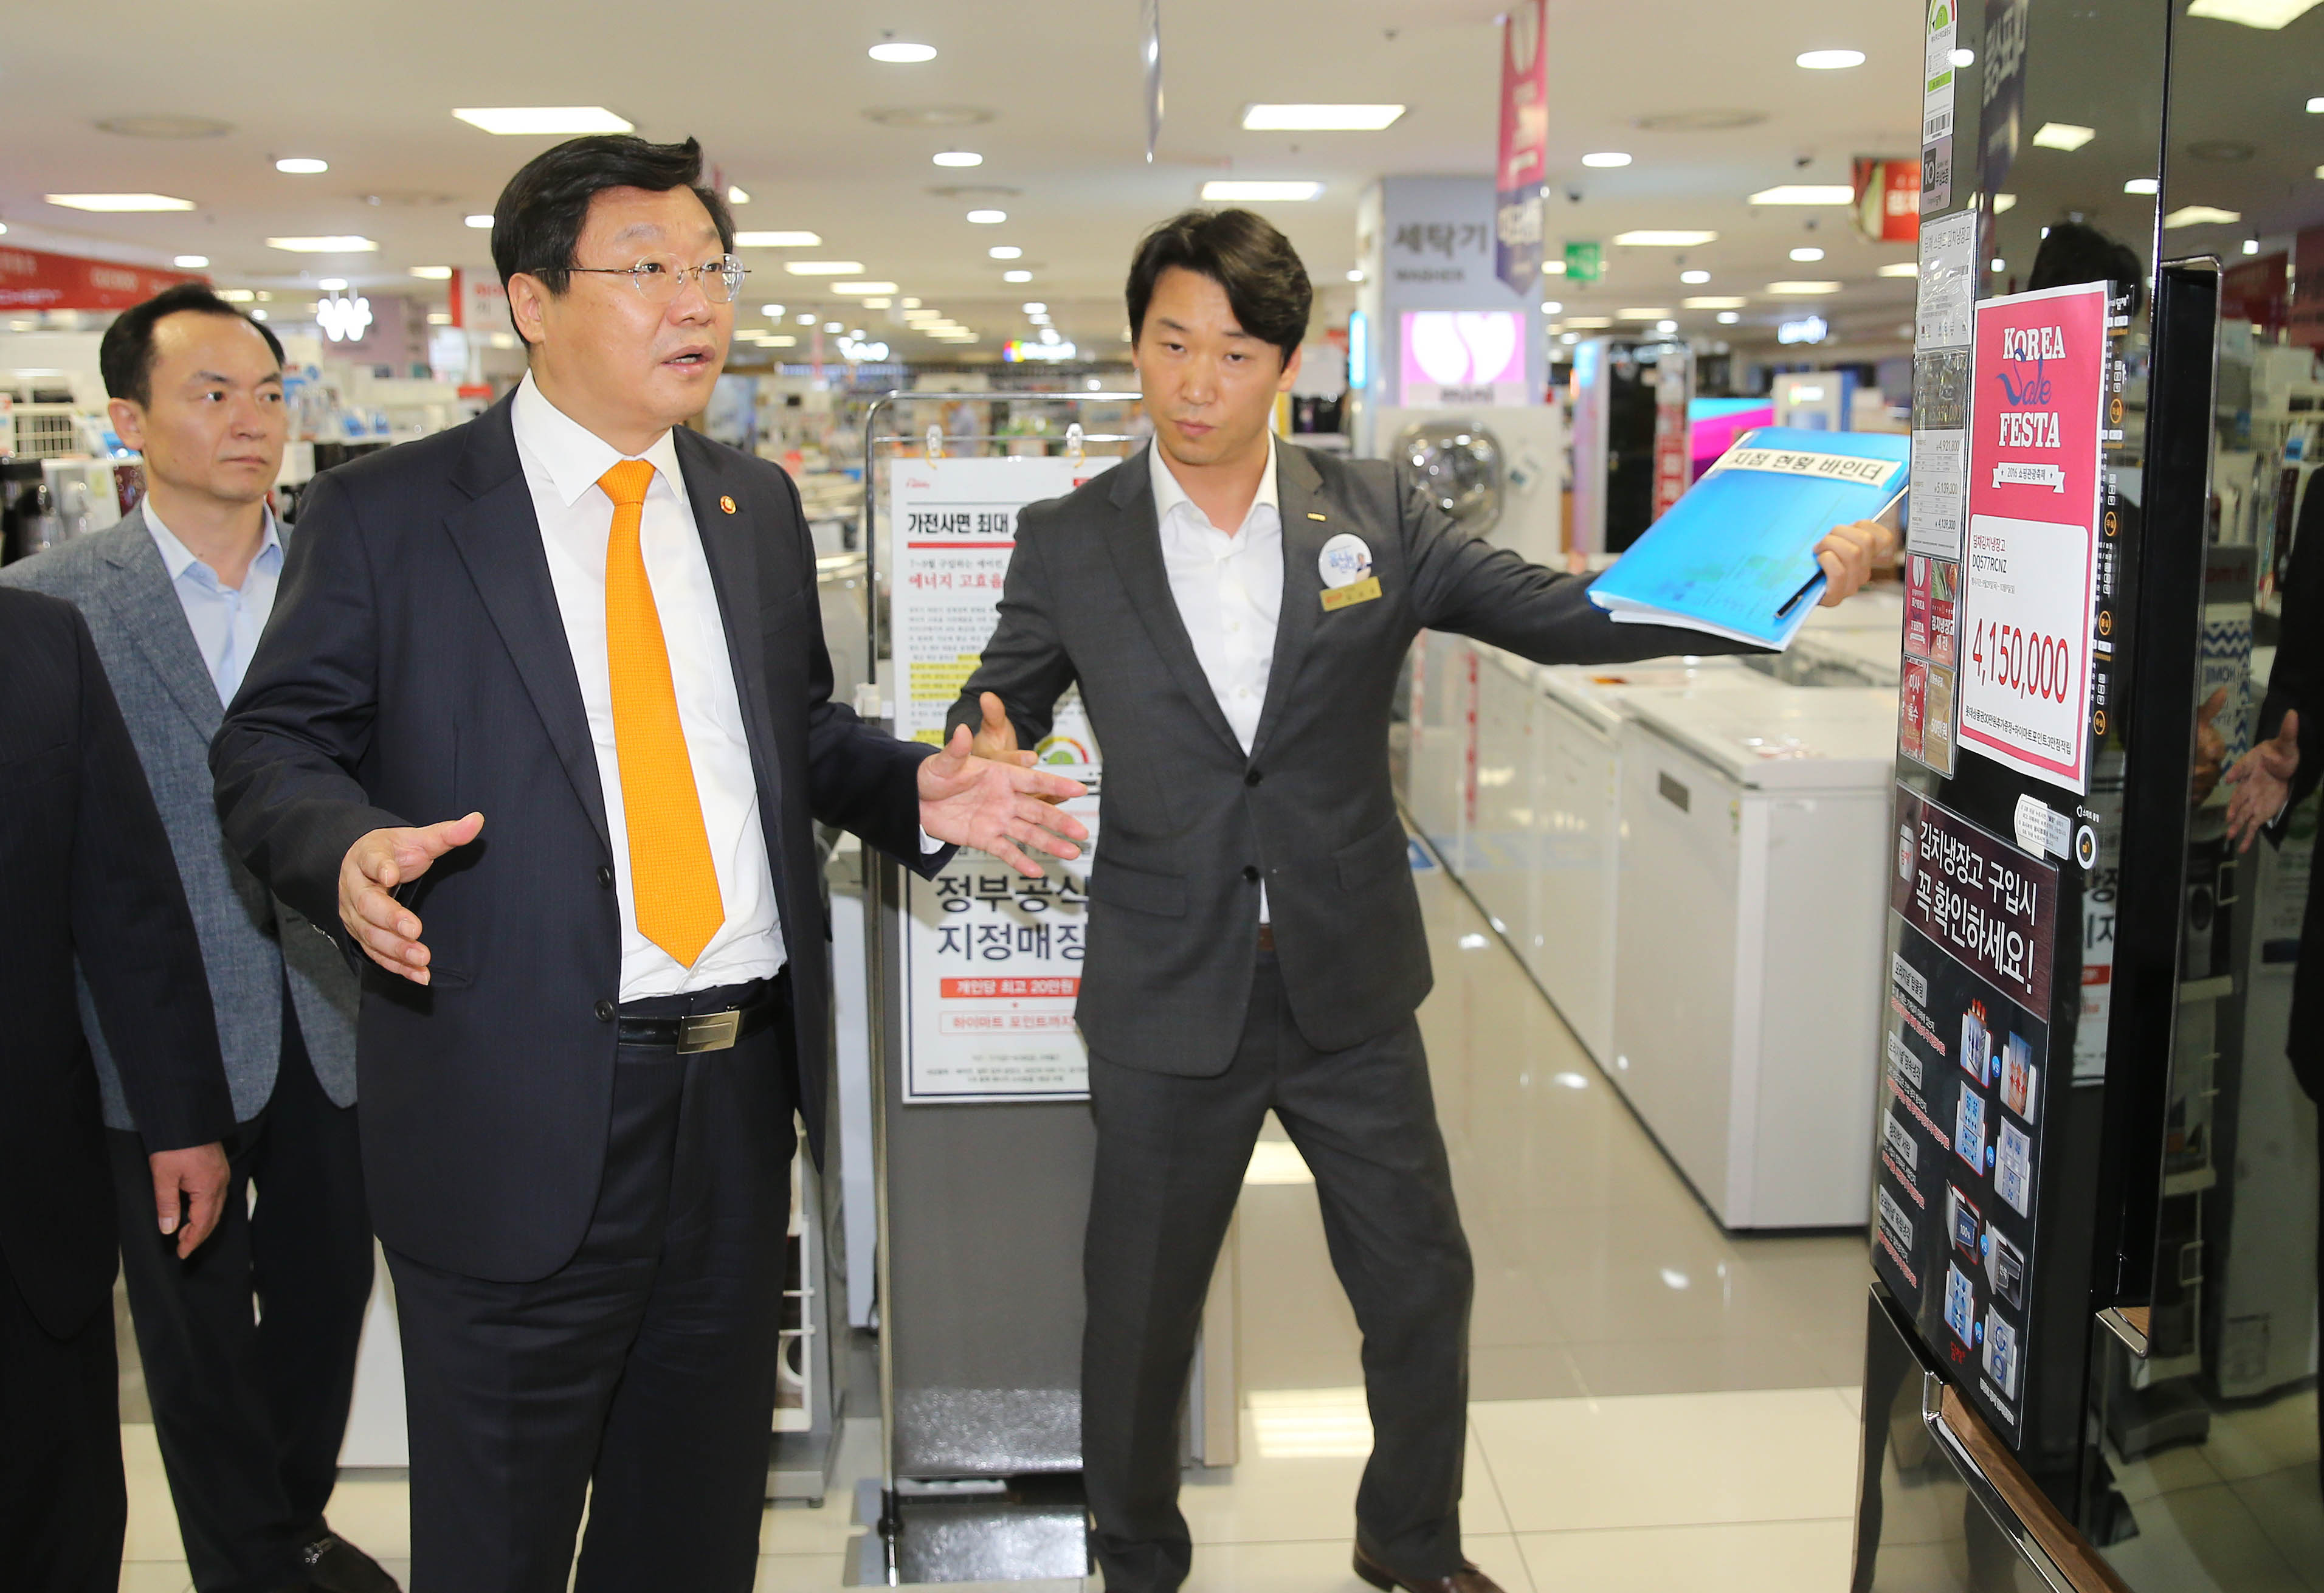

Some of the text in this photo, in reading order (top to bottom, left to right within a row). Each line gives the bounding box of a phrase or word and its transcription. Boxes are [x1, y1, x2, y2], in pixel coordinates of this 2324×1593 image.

[1395, 223, 1487, 260] 세탁기
[2002, 325, 2066, 361] KOREA
[1996, 348, 2052, 406] Sale
[1998, 412, 2061, 449] FESTA
[1773, 455, 1815, 471] 현황
[1819, 458, 1884, 481] 바인더
[2007, 467, 2046, 482] 2016 쇼핑관광축제
[908, 513, 1009, 534] 가전사면 최대
[1972, 554, 2007, 573] DQ577RCNZ
[909, 572, 953, 590] 에너지
[1973, 618, 2069, 704] 4,150,000
[1920, 821, 1984, 891] 김치냉장고
[1988, 861, 2036, 927] 구입시
[1001, 980, 1027, 994] 최고
[1031, 979, 1074, 994] 20만원
[954, 1015, 1003, 1028] 하이마트
